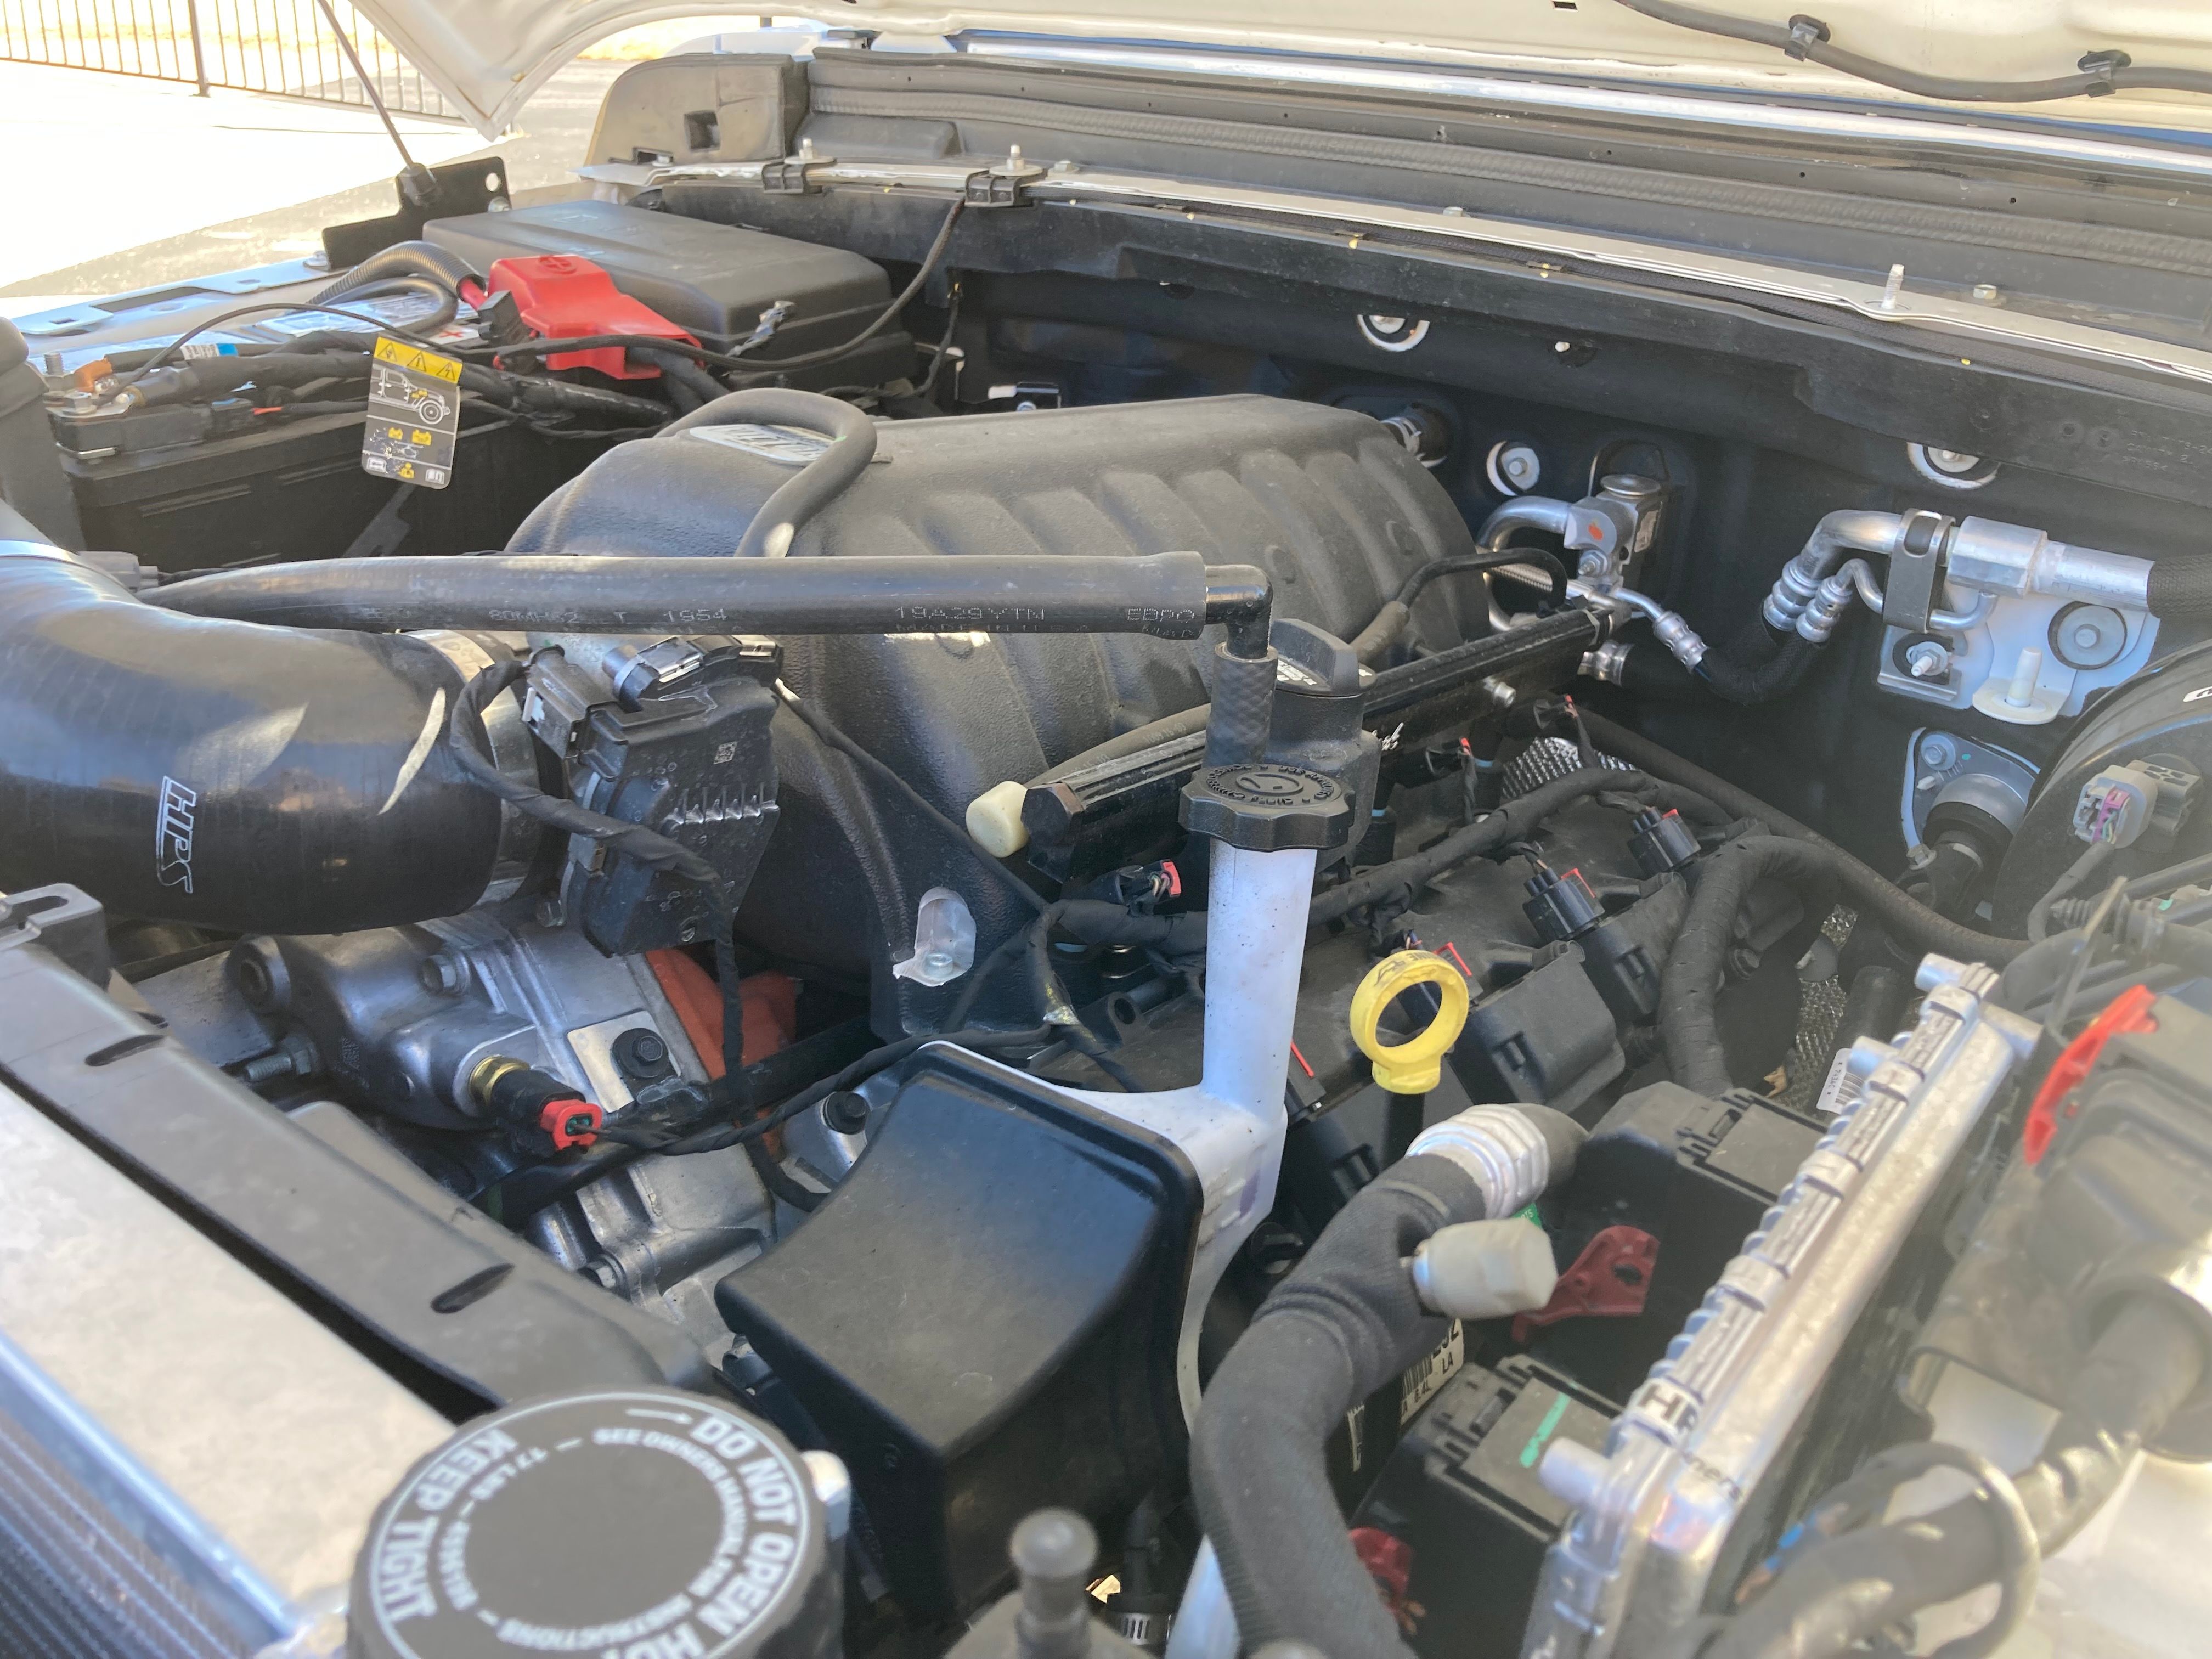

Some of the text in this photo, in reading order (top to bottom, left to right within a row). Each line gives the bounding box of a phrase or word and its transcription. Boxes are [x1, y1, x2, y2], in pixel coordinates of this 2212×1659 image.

[663, 608, 728, 623] 1954
[1305, 772, 1335, 800] APPROVED
[156, 776, 196, 894] HPS
[1441, 1351, 1454, 1375] LA
[416, 1428, 518, 1511] KEEP
[690, 1417, 758, 1460] DO
[738, 1456, 798, 1526] NOT
[382, 1514, 439, 1621] TIGHT
[697, 1532, 795, 1637] OPEN
